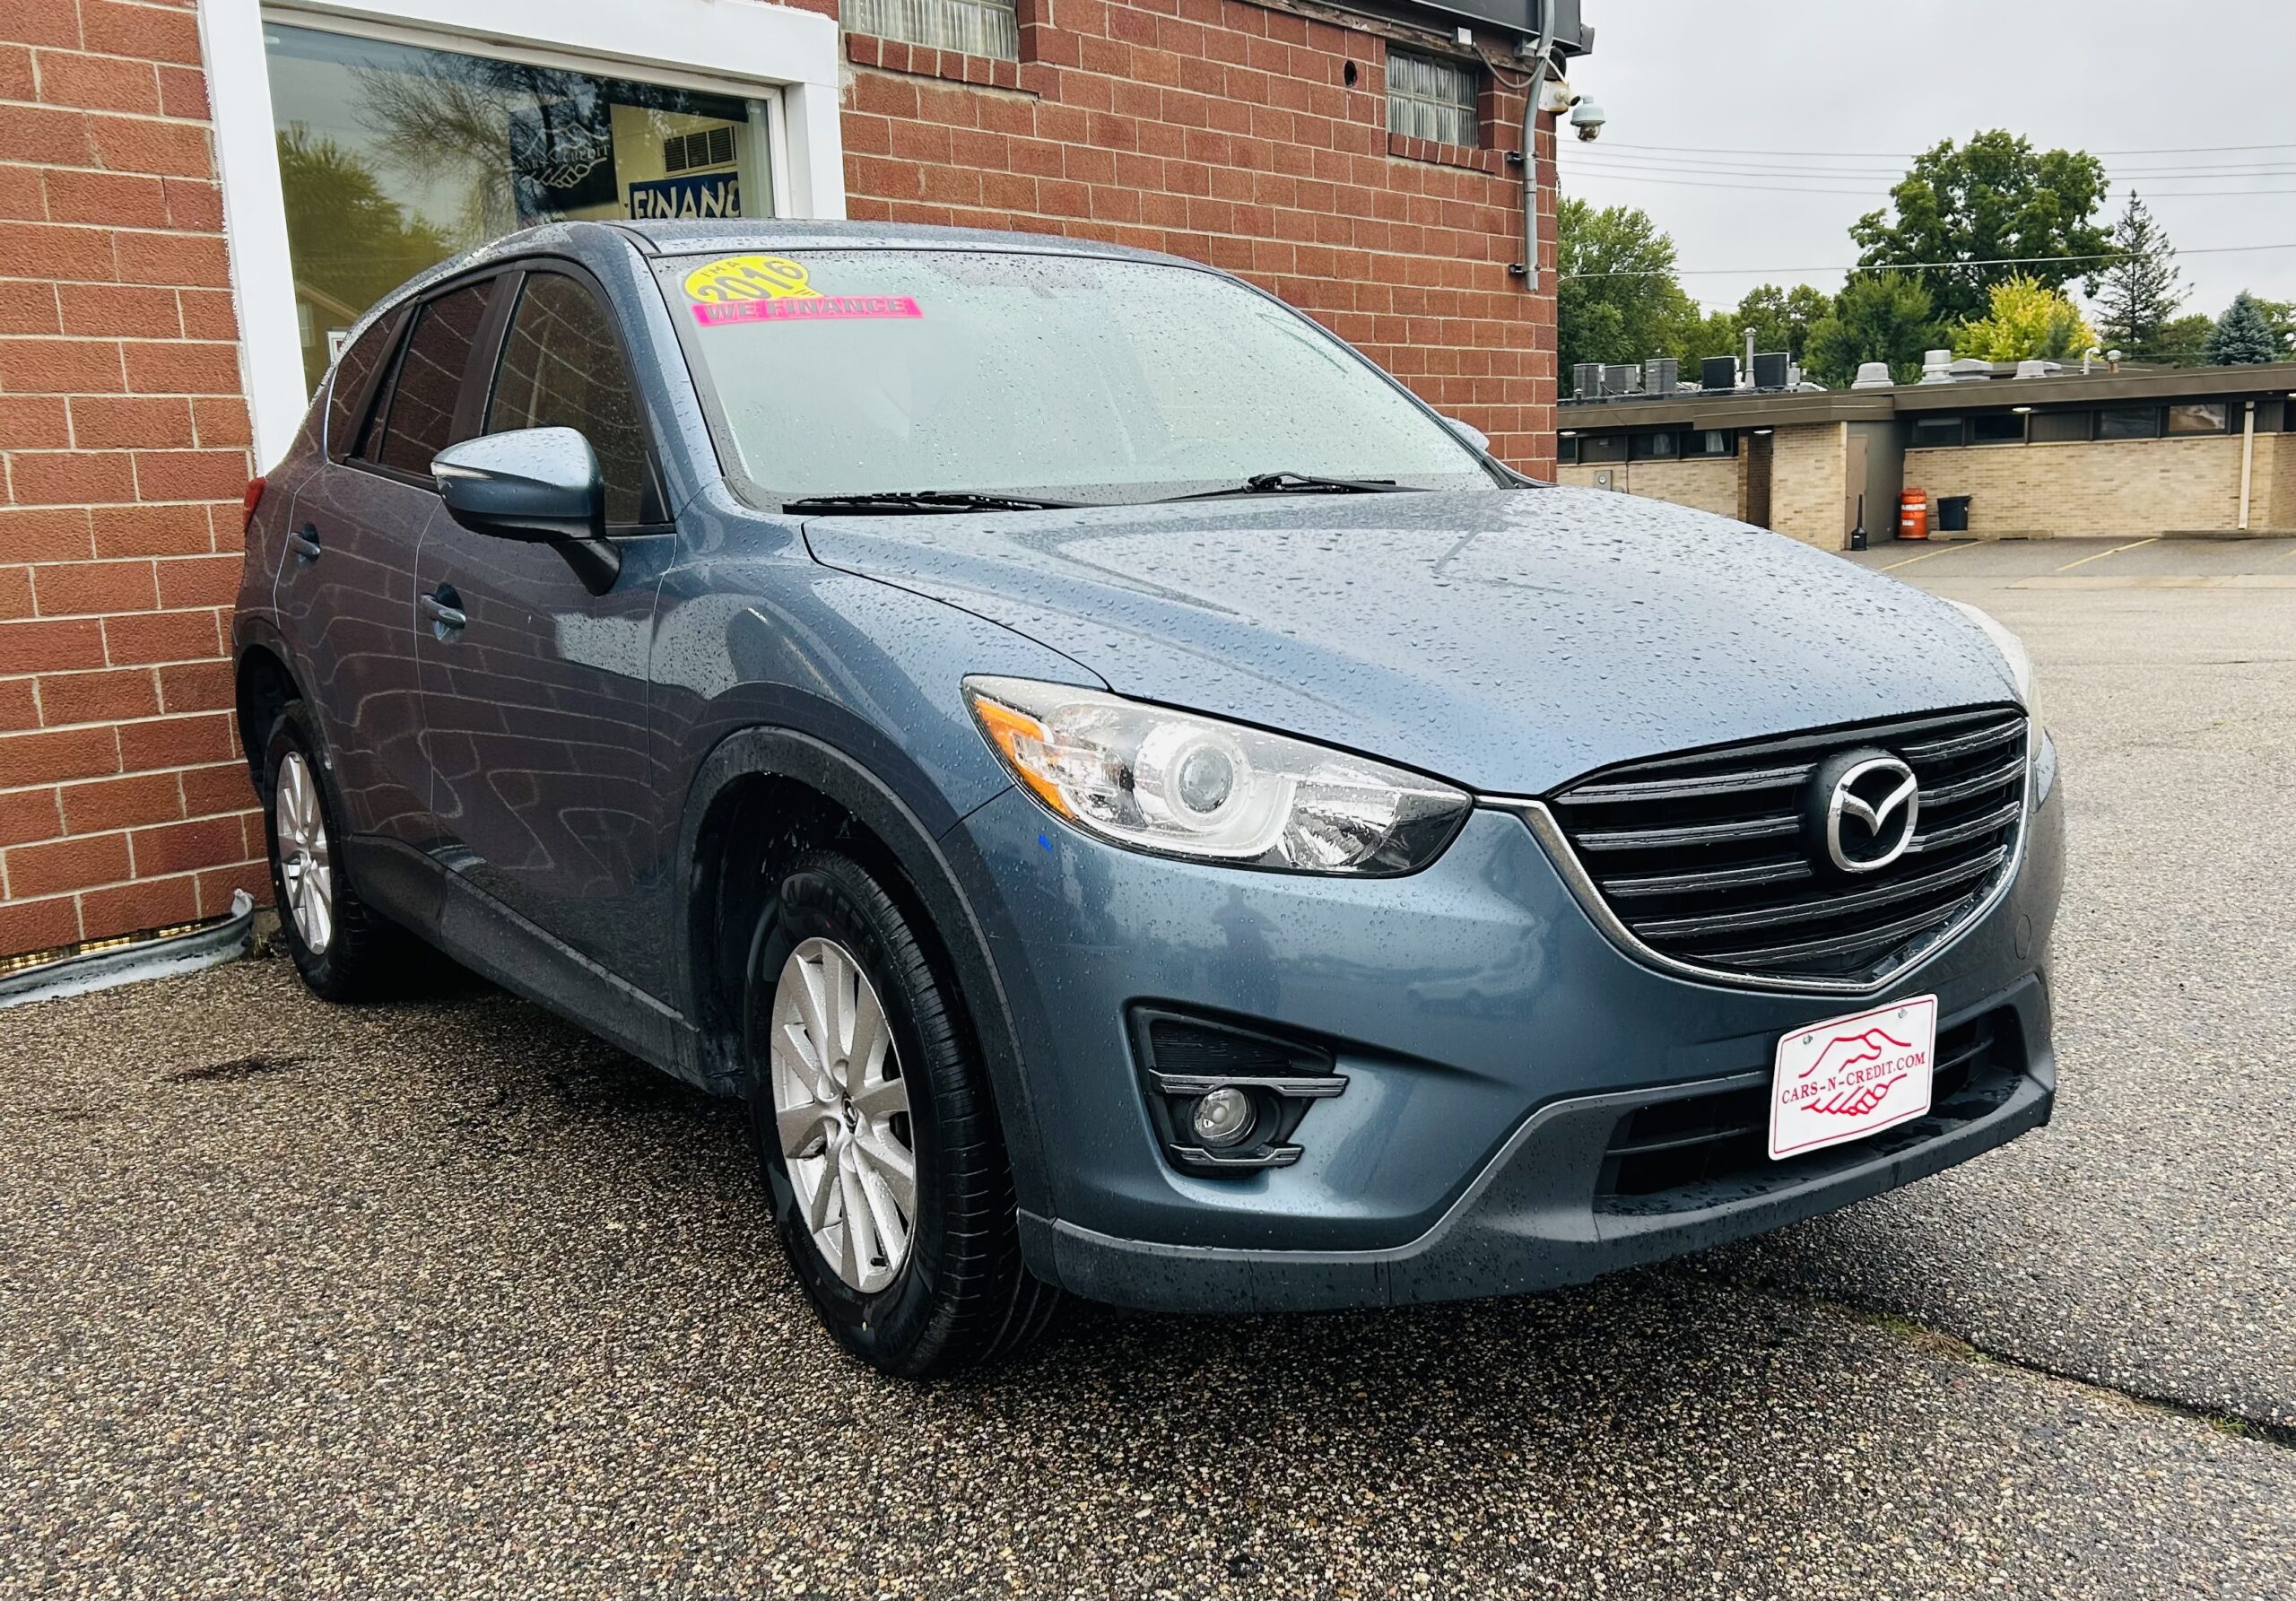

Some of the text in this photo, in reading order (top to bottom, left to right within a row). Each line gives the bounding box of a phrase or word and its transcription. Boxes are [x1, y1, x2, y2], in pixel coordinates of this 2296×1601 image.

[697, 260, 804, 302] 2016
[706, 297, 905, 320] WE FINANCE
[1781, 1051, 1926, 1104] CARS-N-CREDIT.COM
